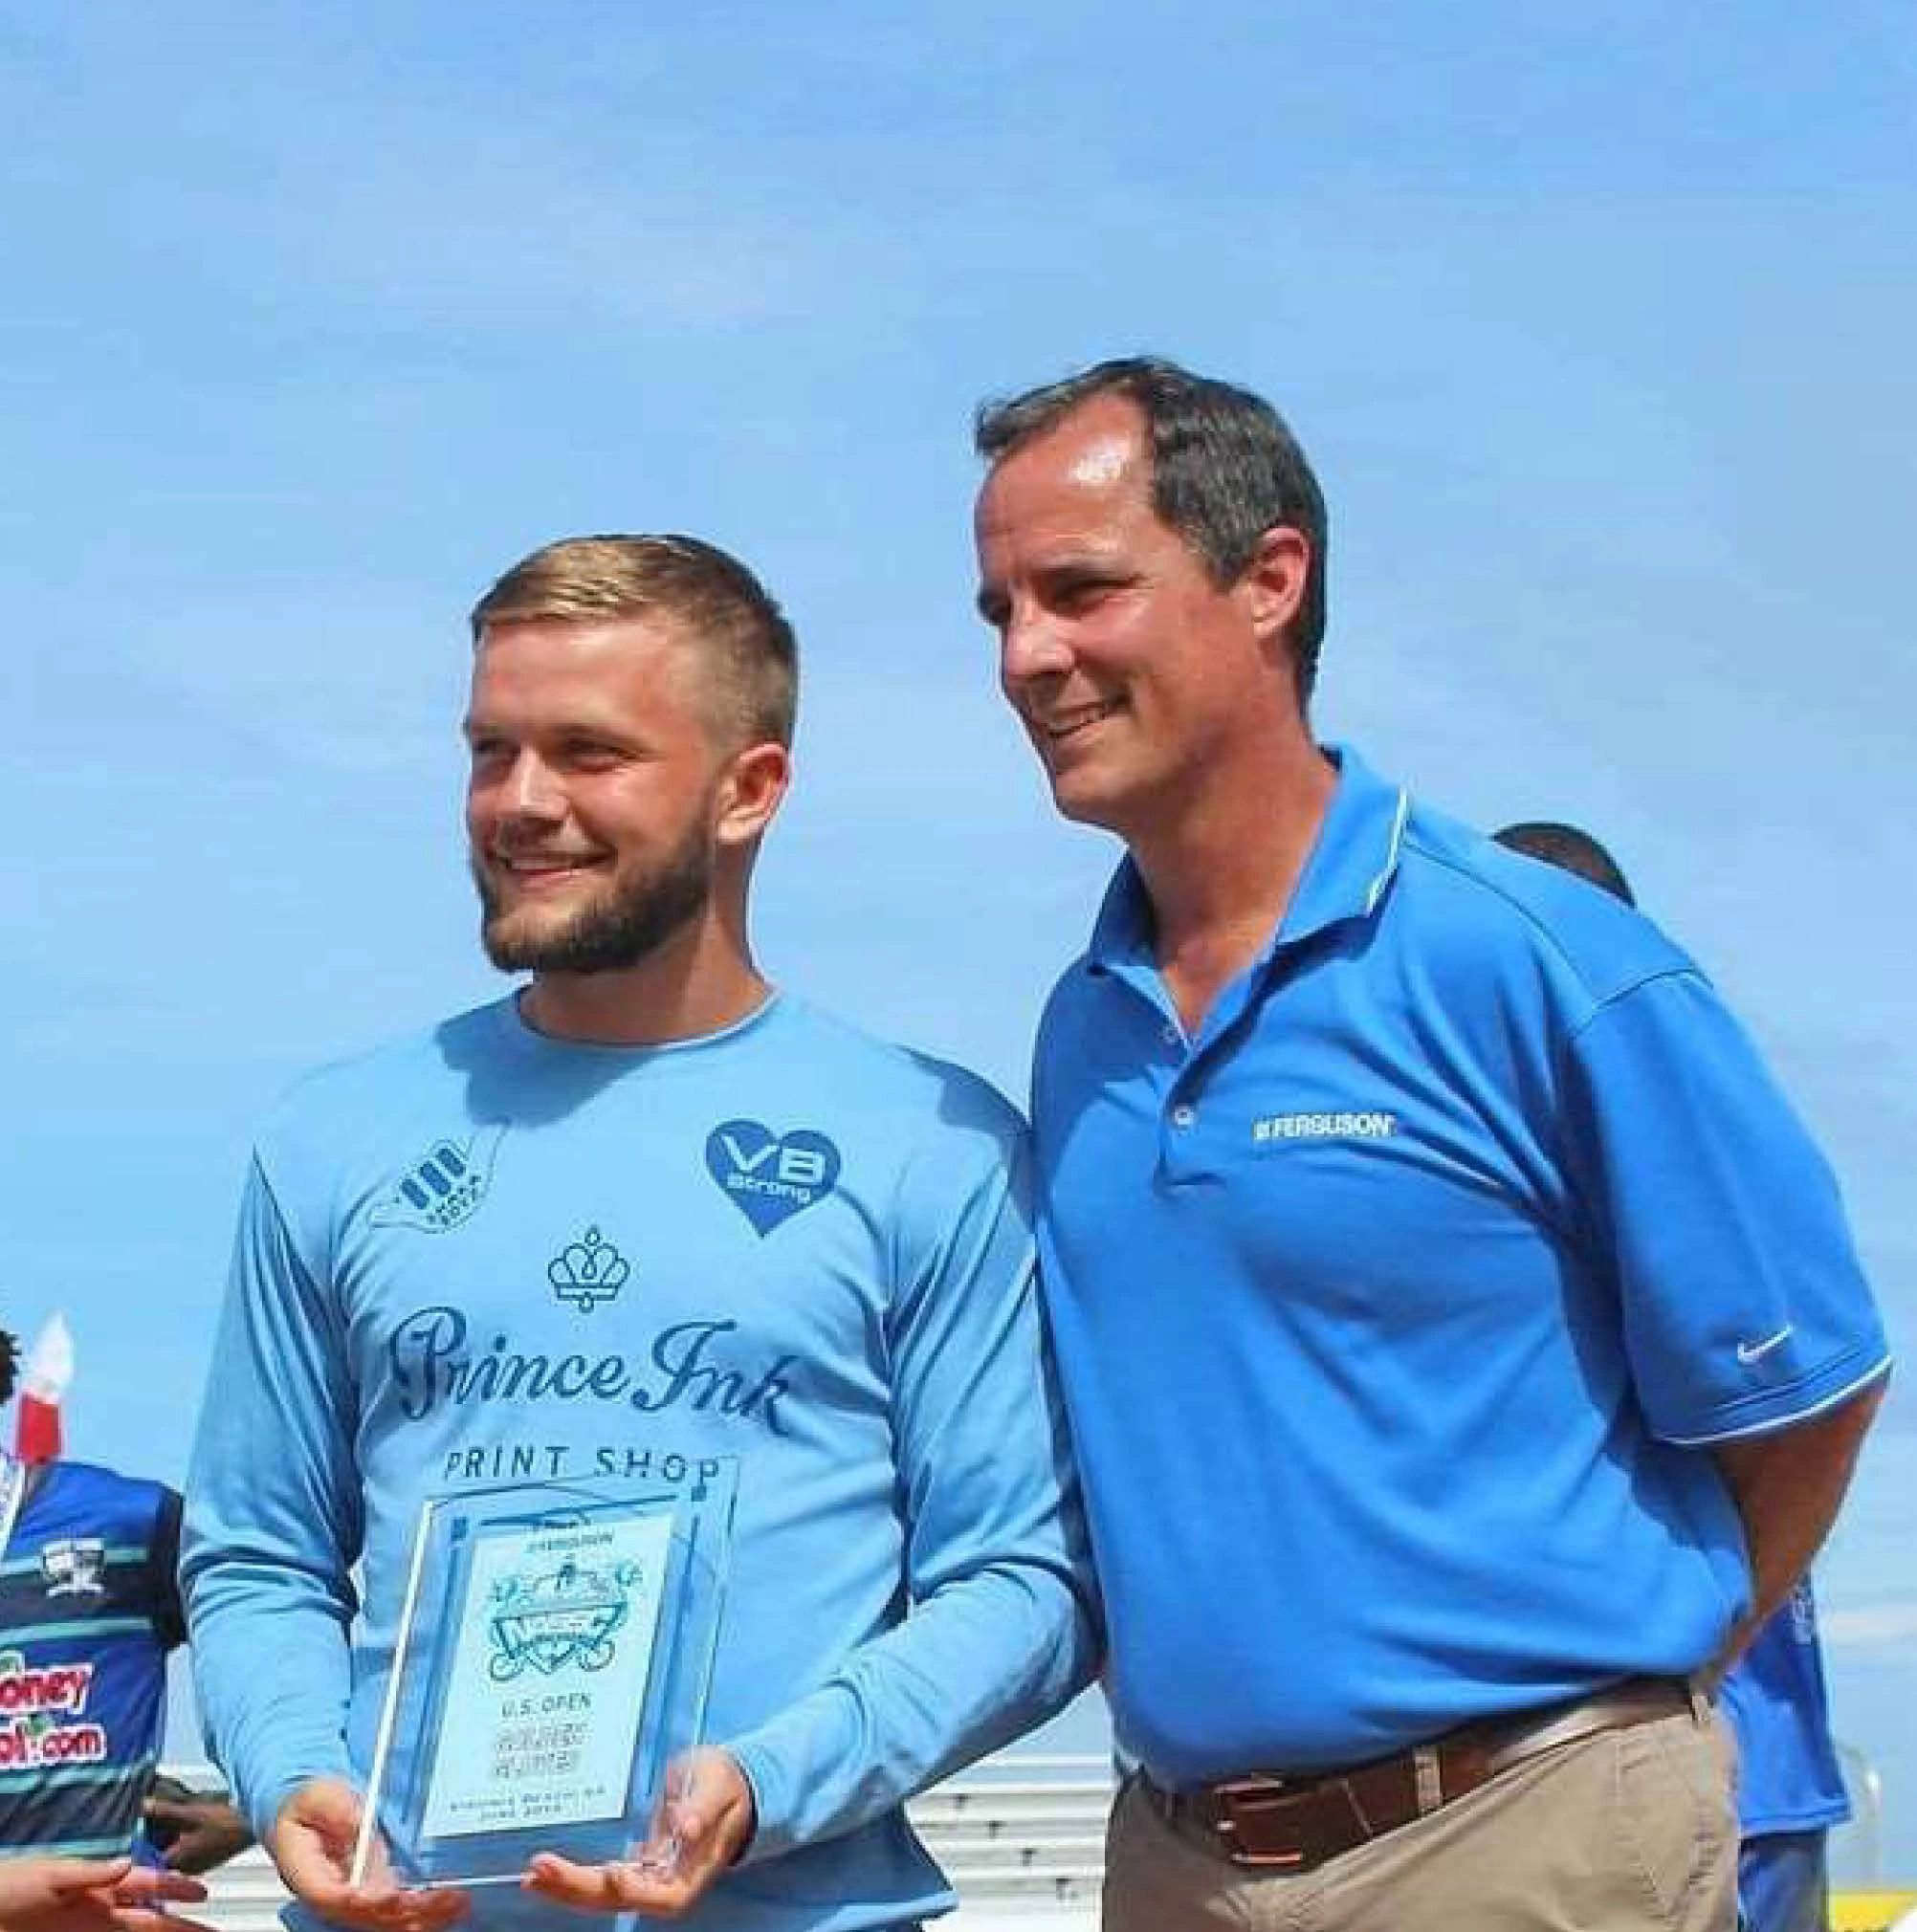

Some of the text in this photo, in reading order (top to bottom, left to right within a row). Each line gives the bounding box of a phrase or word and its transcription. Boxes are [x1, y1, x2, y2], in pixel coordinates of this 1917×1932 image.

[1273, 1112, 1394, 1138] FERGUSON
[722, 1133, 826, 1184] VB
[390, 1305, 801, 1439] Prince Ink
[445, 1445, 719, 1487] PRINT SHOP
[541, 1692, 592, 1714] OPEN
